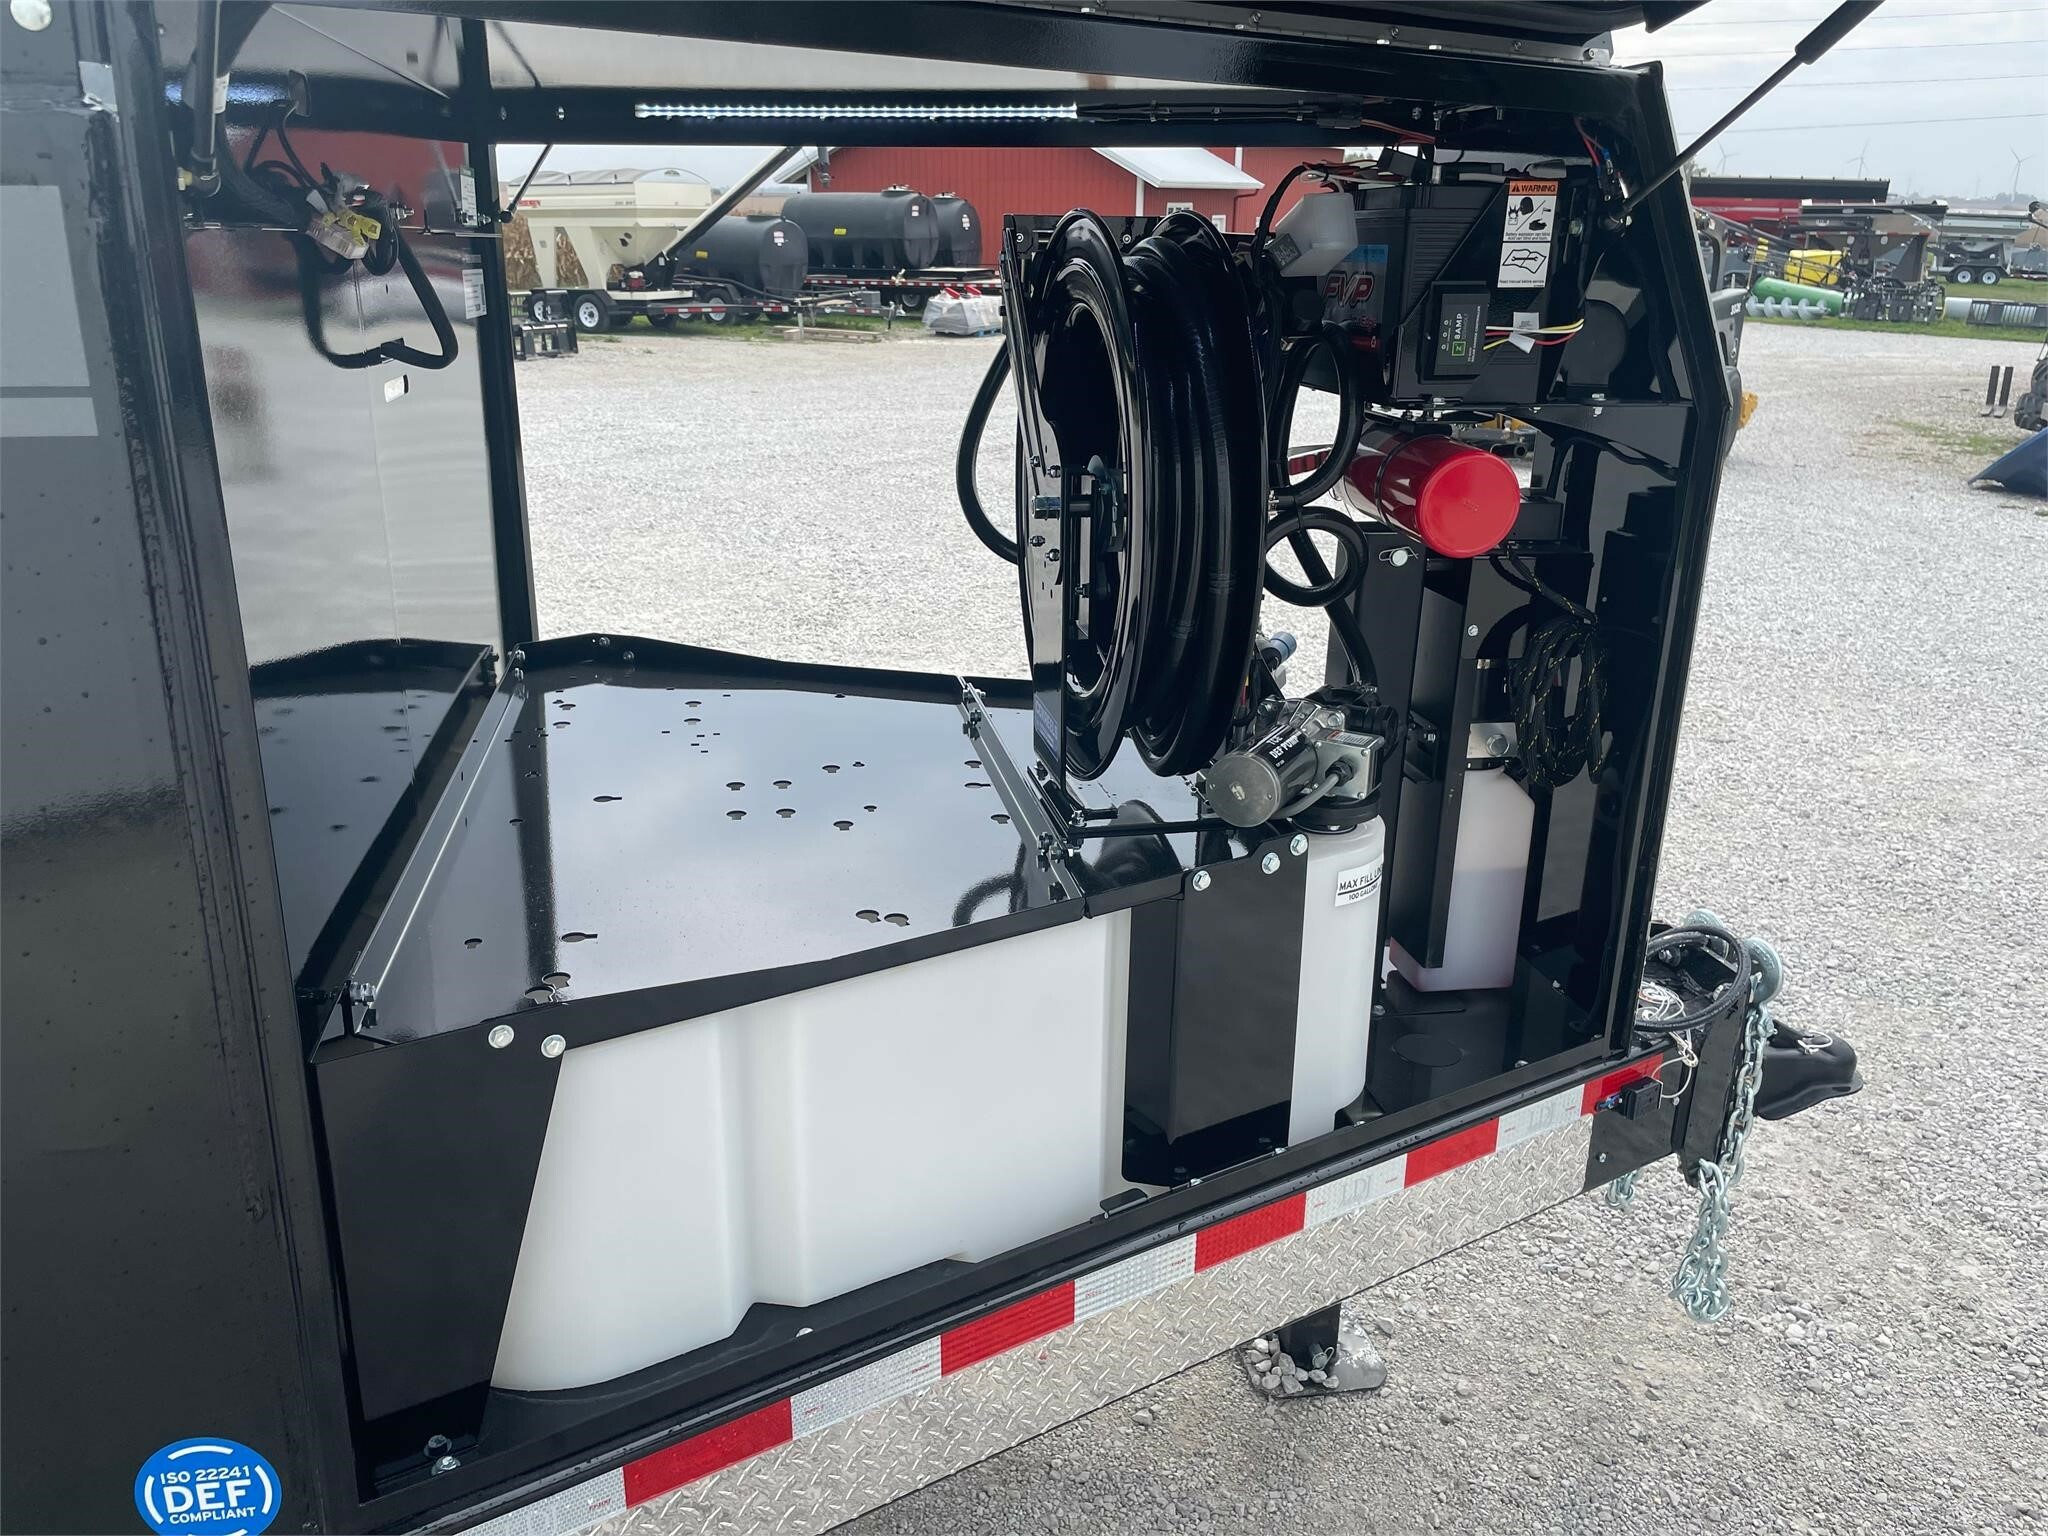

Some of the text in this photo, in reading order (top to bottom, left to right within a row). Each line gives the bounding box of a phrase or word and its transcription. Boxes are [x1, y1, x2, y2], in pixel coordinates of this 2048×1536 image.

[1521, 184, 1556, 193] WARNING
[1269, 735, 1299, 758] DEF PUMP
[1339, 878, 1358, 891] MAX
[1360, 873, 1373, 886] FILL
[160, 1465, 250, 1485] ISO 22241
[162, 1478, 252, 1514] DEF
[169, 1506, 256, 1525] COMPLIANT
